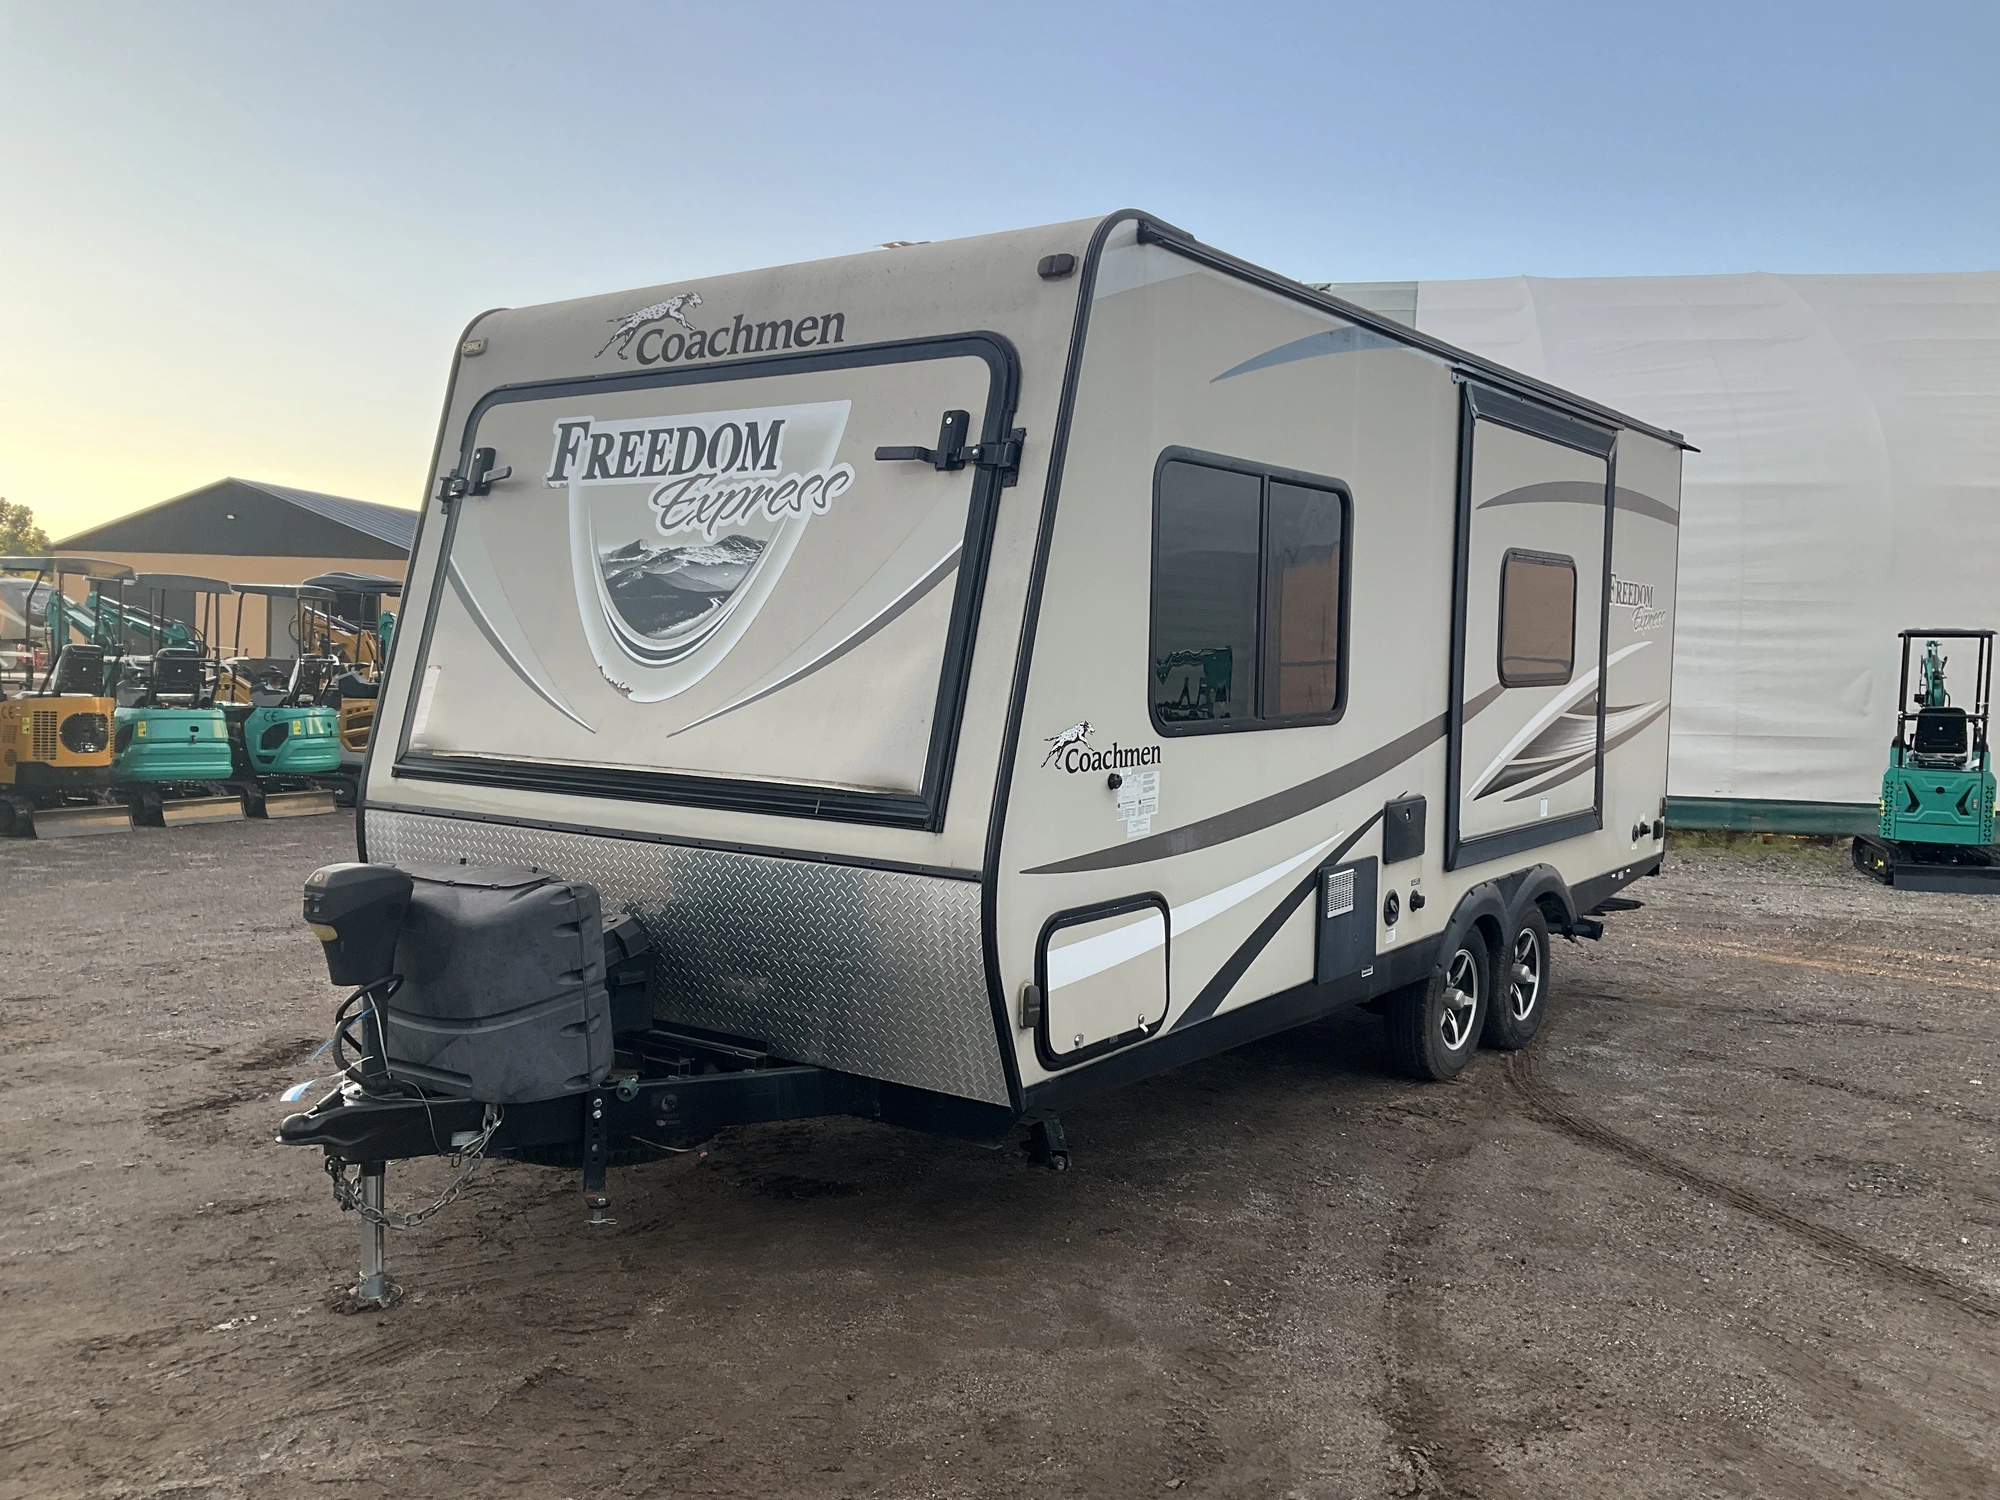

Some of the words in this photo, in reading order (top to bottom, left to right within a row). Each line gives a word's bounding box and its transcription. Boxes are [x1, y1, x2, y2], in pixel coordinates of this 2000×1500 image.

[637, 312, 845, 365] Coachmen
[547, 420, 786, 481] FREEDOM
[653, 470, 849, 536] Express
[1632, 606, 1666, 634] Express
[1065, 742, 1161, 774] Coachmen
